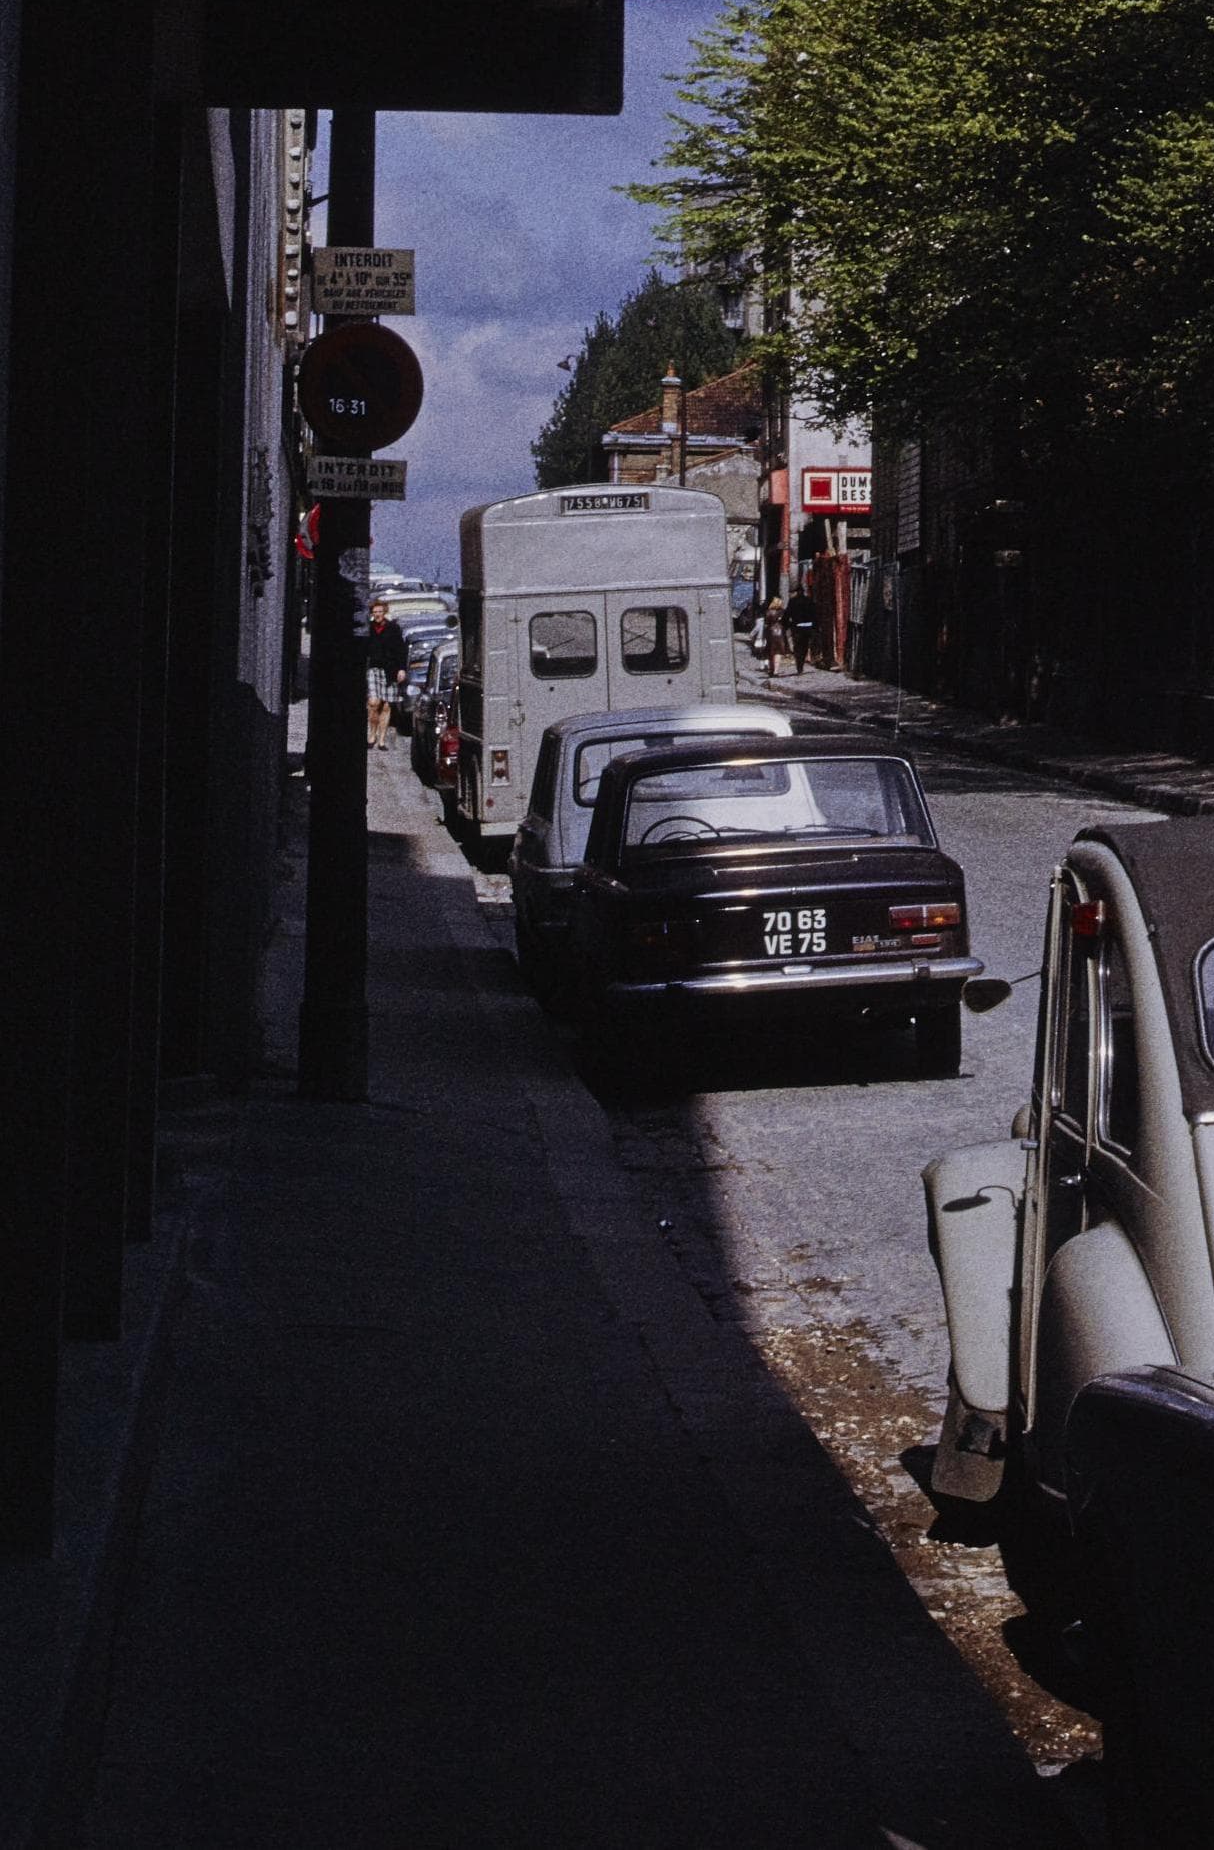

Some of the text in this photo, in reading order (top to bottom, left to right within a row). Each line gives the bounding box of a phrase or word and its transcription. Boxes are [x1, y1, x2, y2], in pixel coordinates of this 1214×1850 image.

[334, 252, 393, 267] INTERDIT
[317, 461, 396, 477] INTERDIT
[321, 477, 335, 490] 16
[841, 476, 871, 488] DUM
[798, 931, 827, 954] 75
